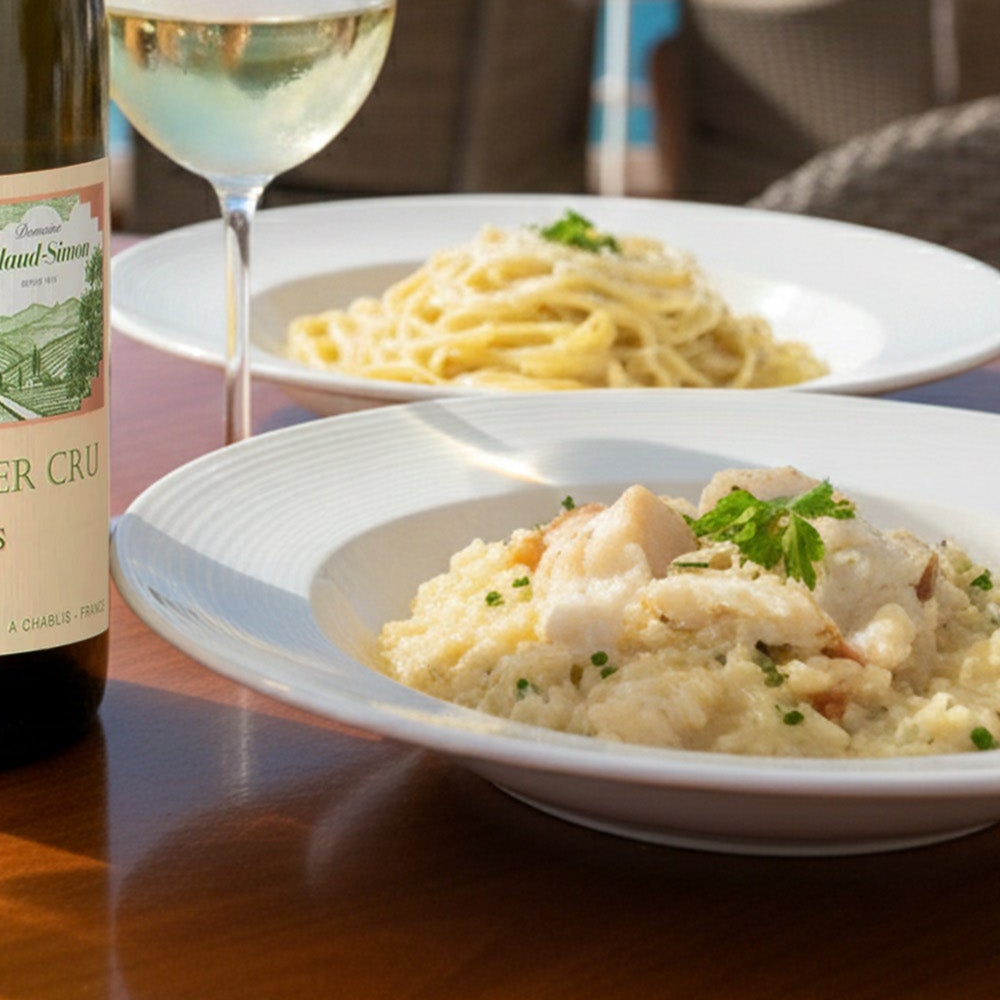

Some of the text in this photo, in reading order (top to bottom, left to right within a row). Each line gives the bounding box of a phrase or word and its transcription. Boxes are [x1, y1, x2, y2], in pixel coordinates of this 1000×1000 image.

[15, 223, 63, 240] Domaine
[46, 442, 99, 486] CRU
[8, 621, 17, 633] A
[22, 610, 71, 632] CHABLIS
